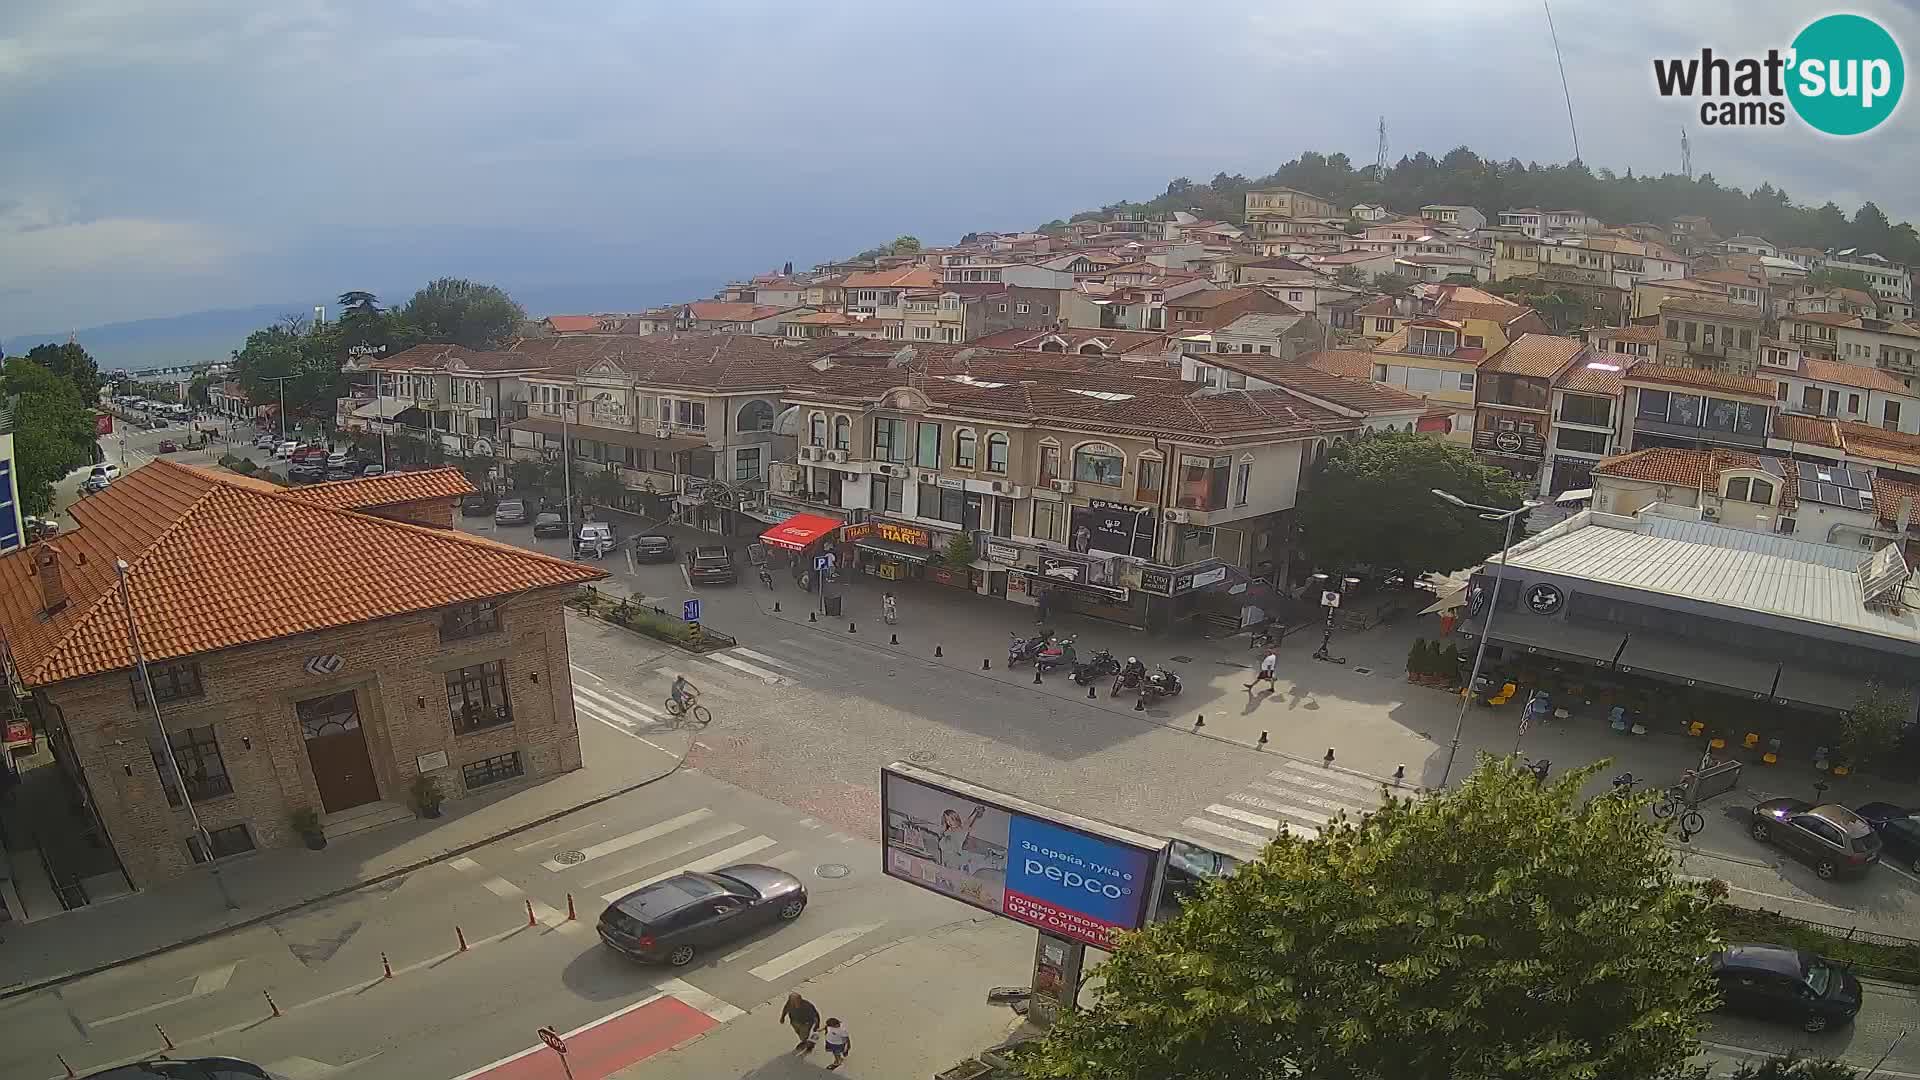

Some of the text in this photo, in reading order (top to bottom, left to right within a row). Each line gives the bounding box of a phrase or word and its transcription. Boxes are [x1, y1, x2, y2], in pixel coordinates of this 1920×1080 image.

[883, 529, 915, 545] HARI
[818, 558, 826, 569] P
[1021, 840, 1038, 852] За
[1089, 861, 1120, 877] тука
[1122, 873, 1133, 881] е
[1008, 903, 1047, 921] 02.07
[1049, 917, 1096, 939] Охрид
[540, 1031, 566, 1050] STOP
